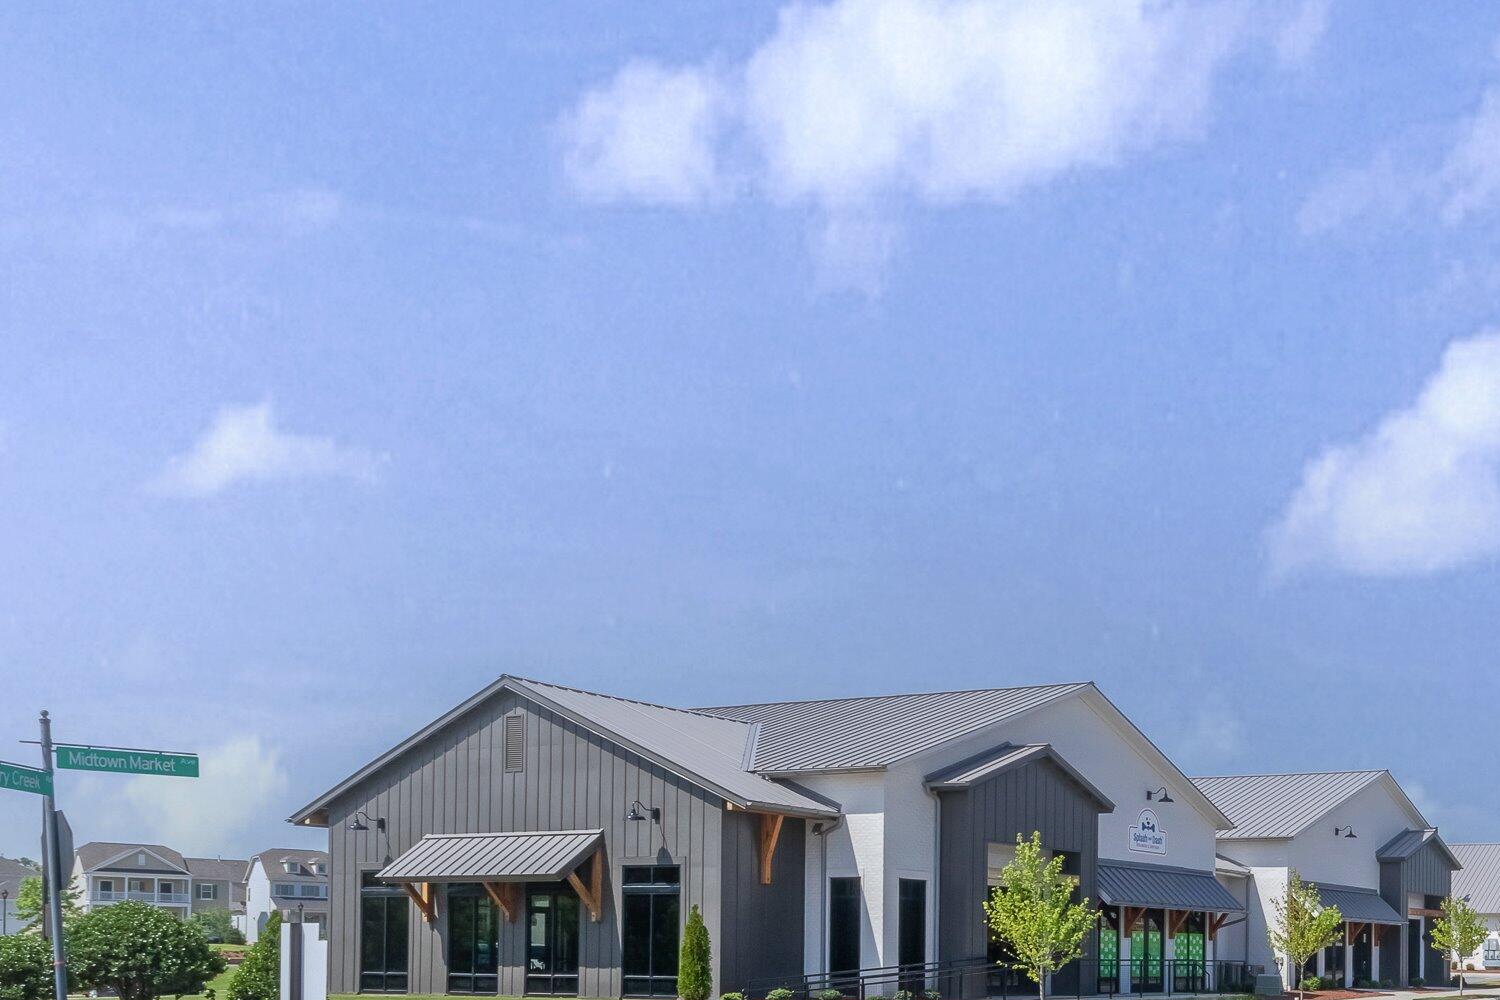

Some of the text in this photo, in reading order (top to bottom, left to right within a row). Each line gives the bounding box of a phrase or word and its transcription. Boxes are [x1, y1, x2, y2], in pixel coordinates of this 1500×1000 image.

[69, 751, 126, 769] Midtown
[130, 755, 176, 772] Market
[12, 770, 41, 789] Creek
